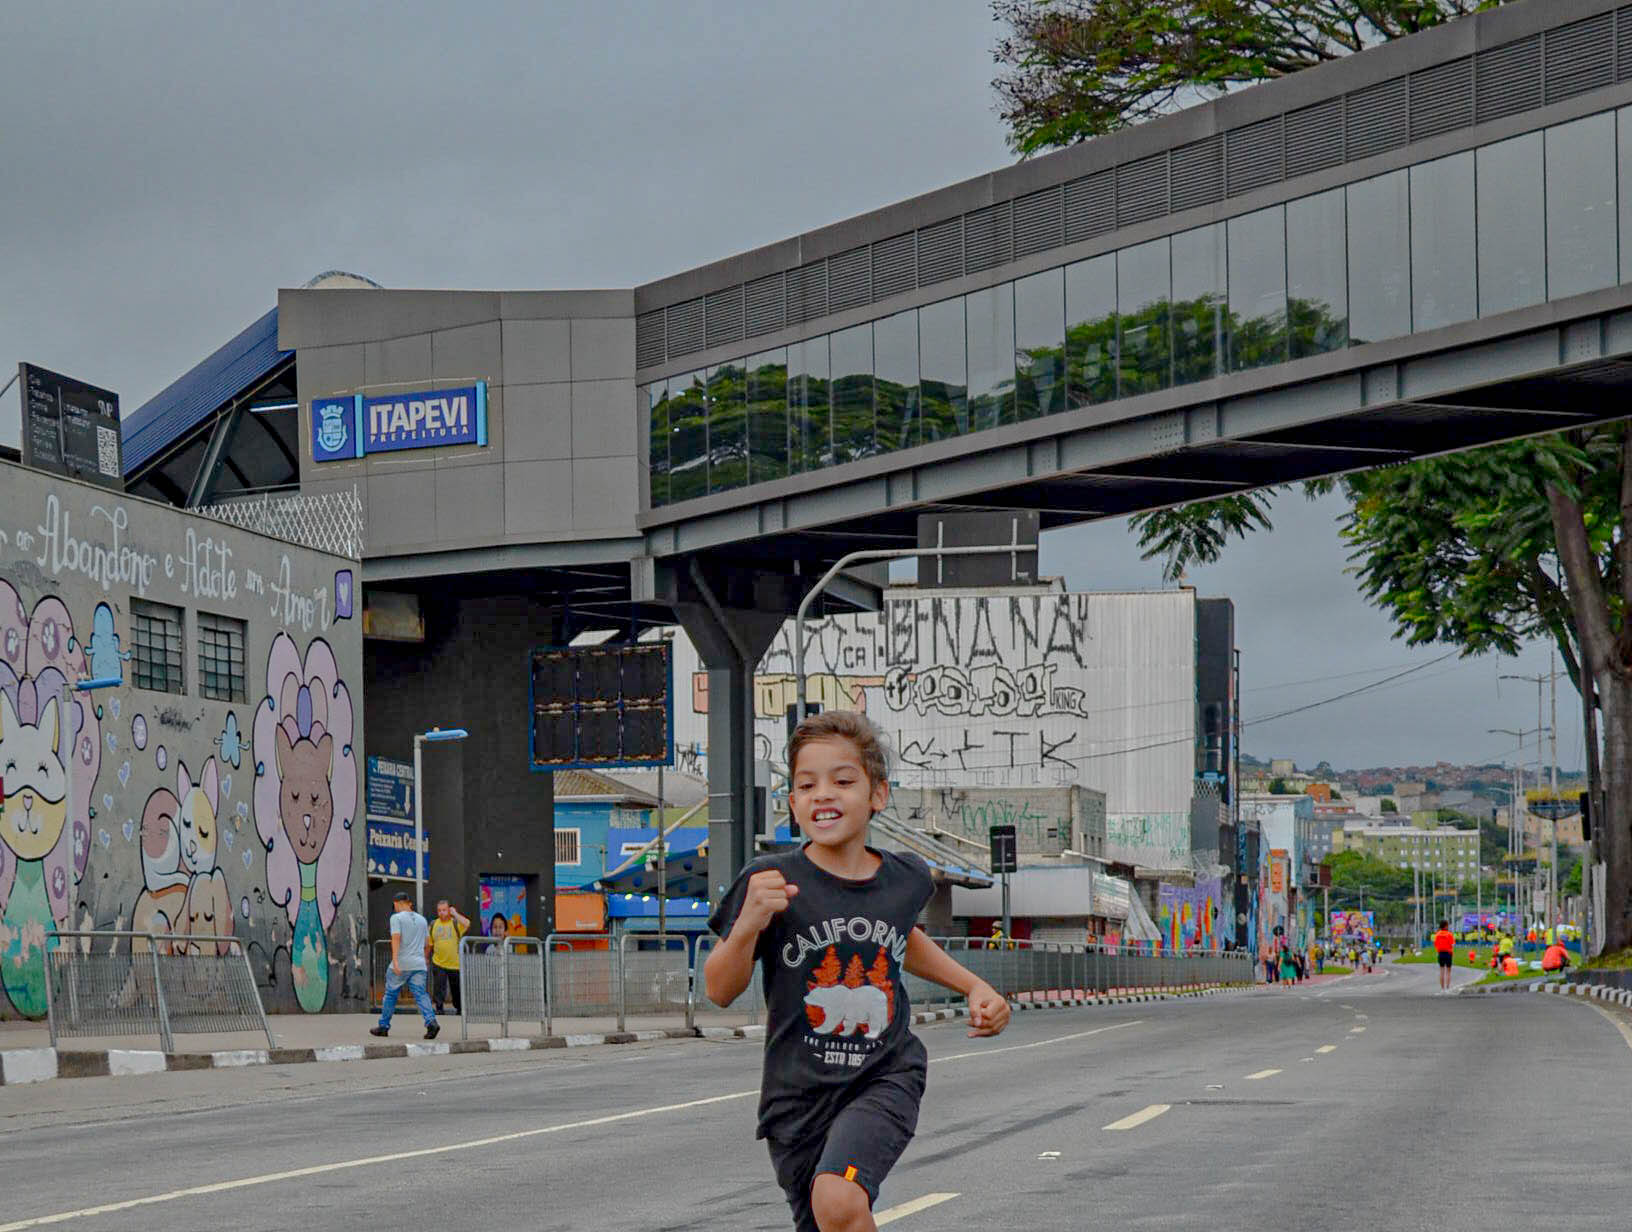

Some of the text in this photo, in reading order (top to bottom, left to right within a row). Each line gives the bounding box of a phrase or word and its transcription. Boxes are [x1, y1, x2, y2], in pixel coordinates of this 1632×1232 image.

[370, 396, 468, 434] ITAPEVI
[370, 426, 469, 443] PREFEITURA
[165, 553, 174, 578] e
[179, 528, 237, 600] Adote
[270, 554, 331, 632] Amor
